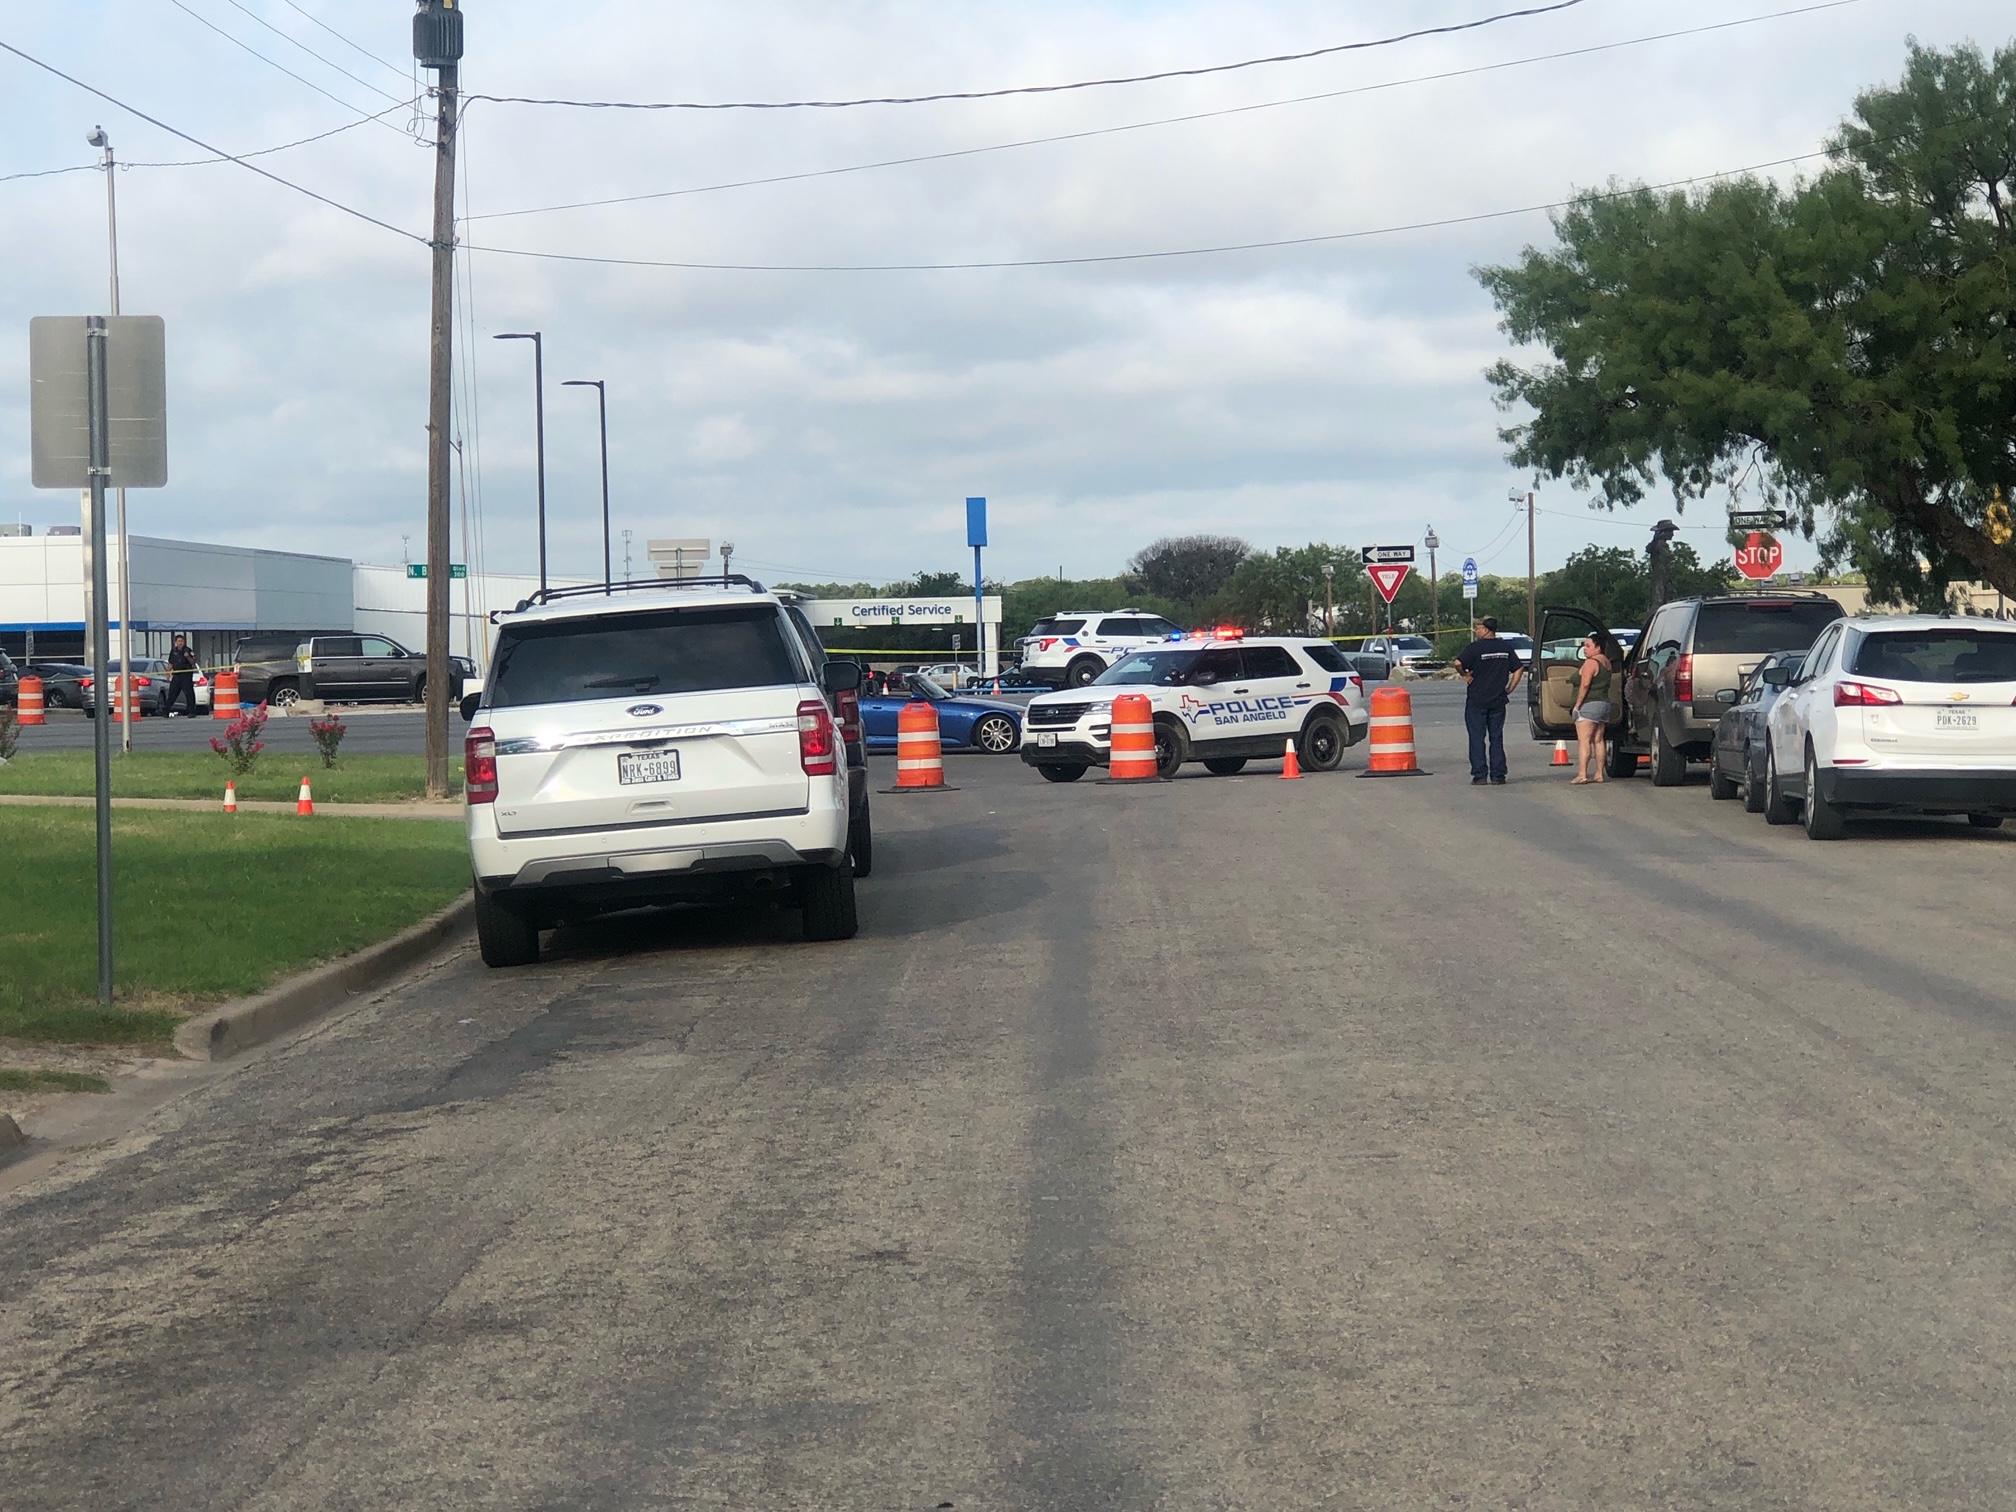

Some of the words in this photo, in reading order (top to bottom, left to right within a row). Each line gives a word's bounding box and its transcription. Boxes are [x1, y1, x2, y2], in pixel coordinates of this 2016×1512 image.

[1735, 516, 1751, 525] ONE
[1753, 515, 1770, 525] WA
[1737, 546, 1780, 565] STOP
[851, 604, 904, 617] Certified
[907, 603, 952, 616] Service
[633, 706, 655, 716] Ford
[1207, 696, 1295, 715] POLICE
[1214, 715, 1240, 726] SAN
[1242, 711, 1287, 723] ANGELO
[580, 726, 713, 743] EXPEDITION
[637, 752, 660, 760] TEXAS
